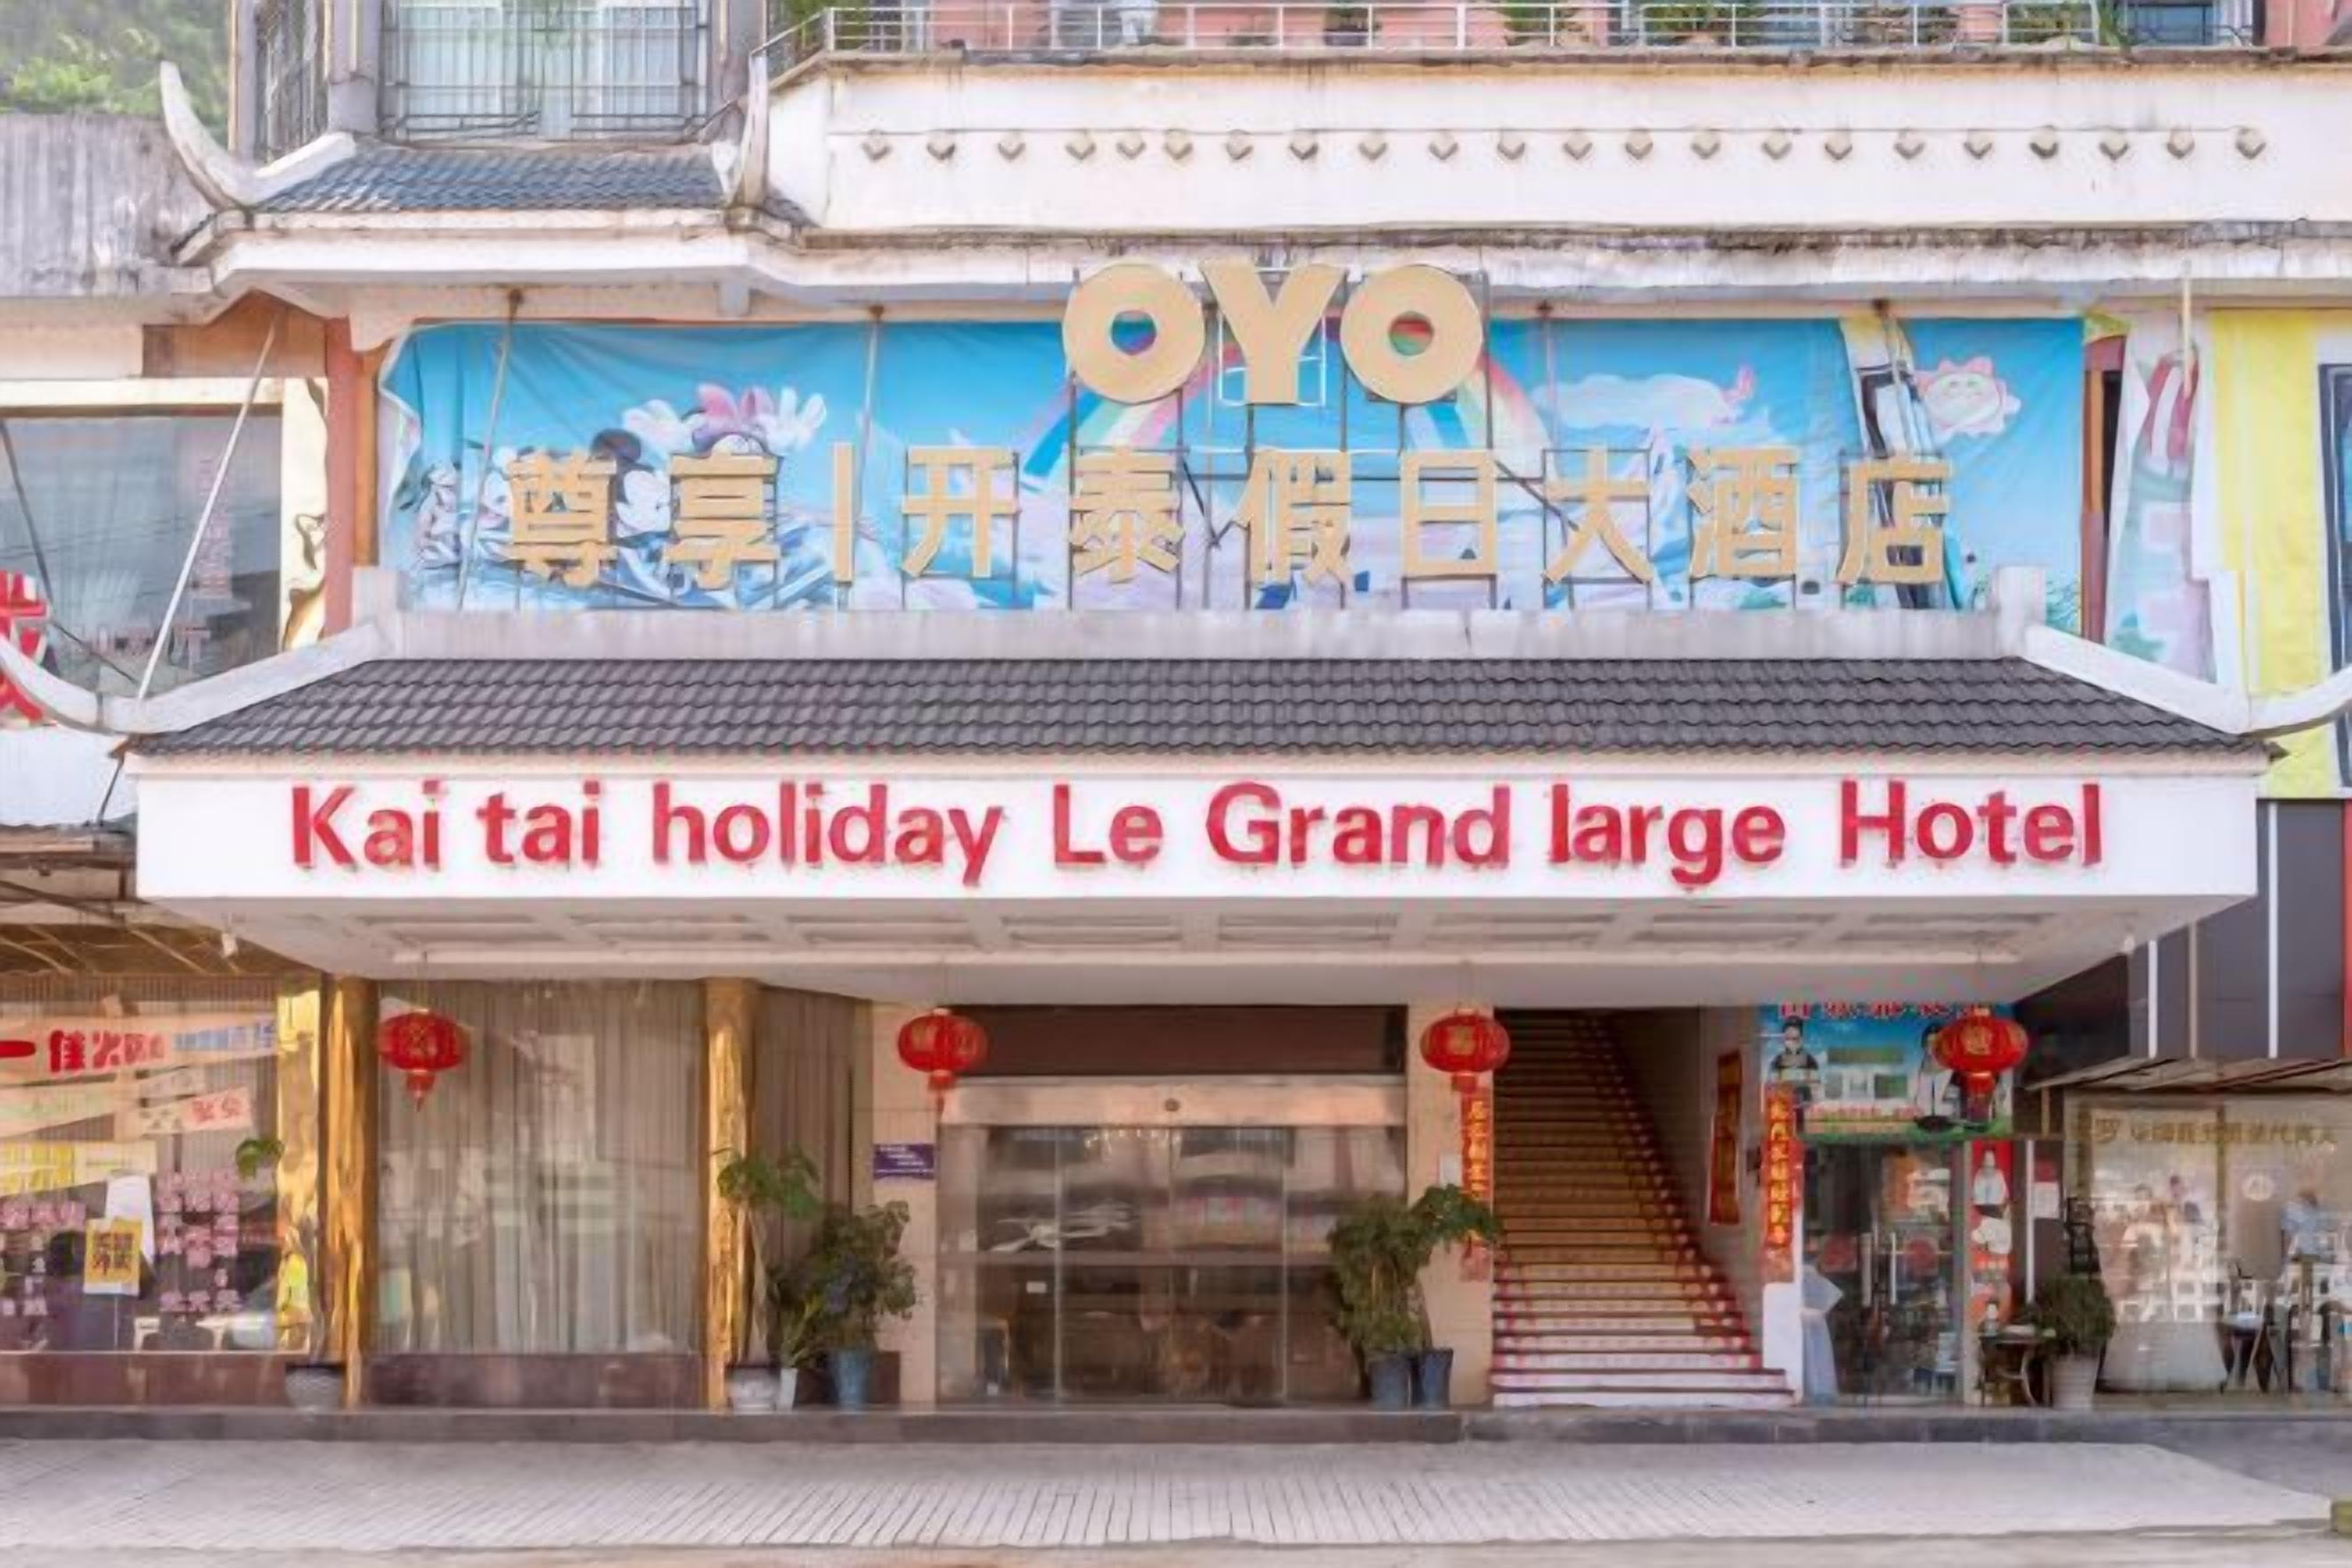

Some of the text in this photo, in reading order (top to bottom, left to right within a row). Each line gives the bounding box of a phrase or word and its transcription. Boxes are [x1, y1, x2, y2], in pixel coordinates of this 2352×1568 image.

[1062, 263, 1484, 404] OYO
[292, 778, 2102, 887] Kai tai holiday Le Grand large Hotel
